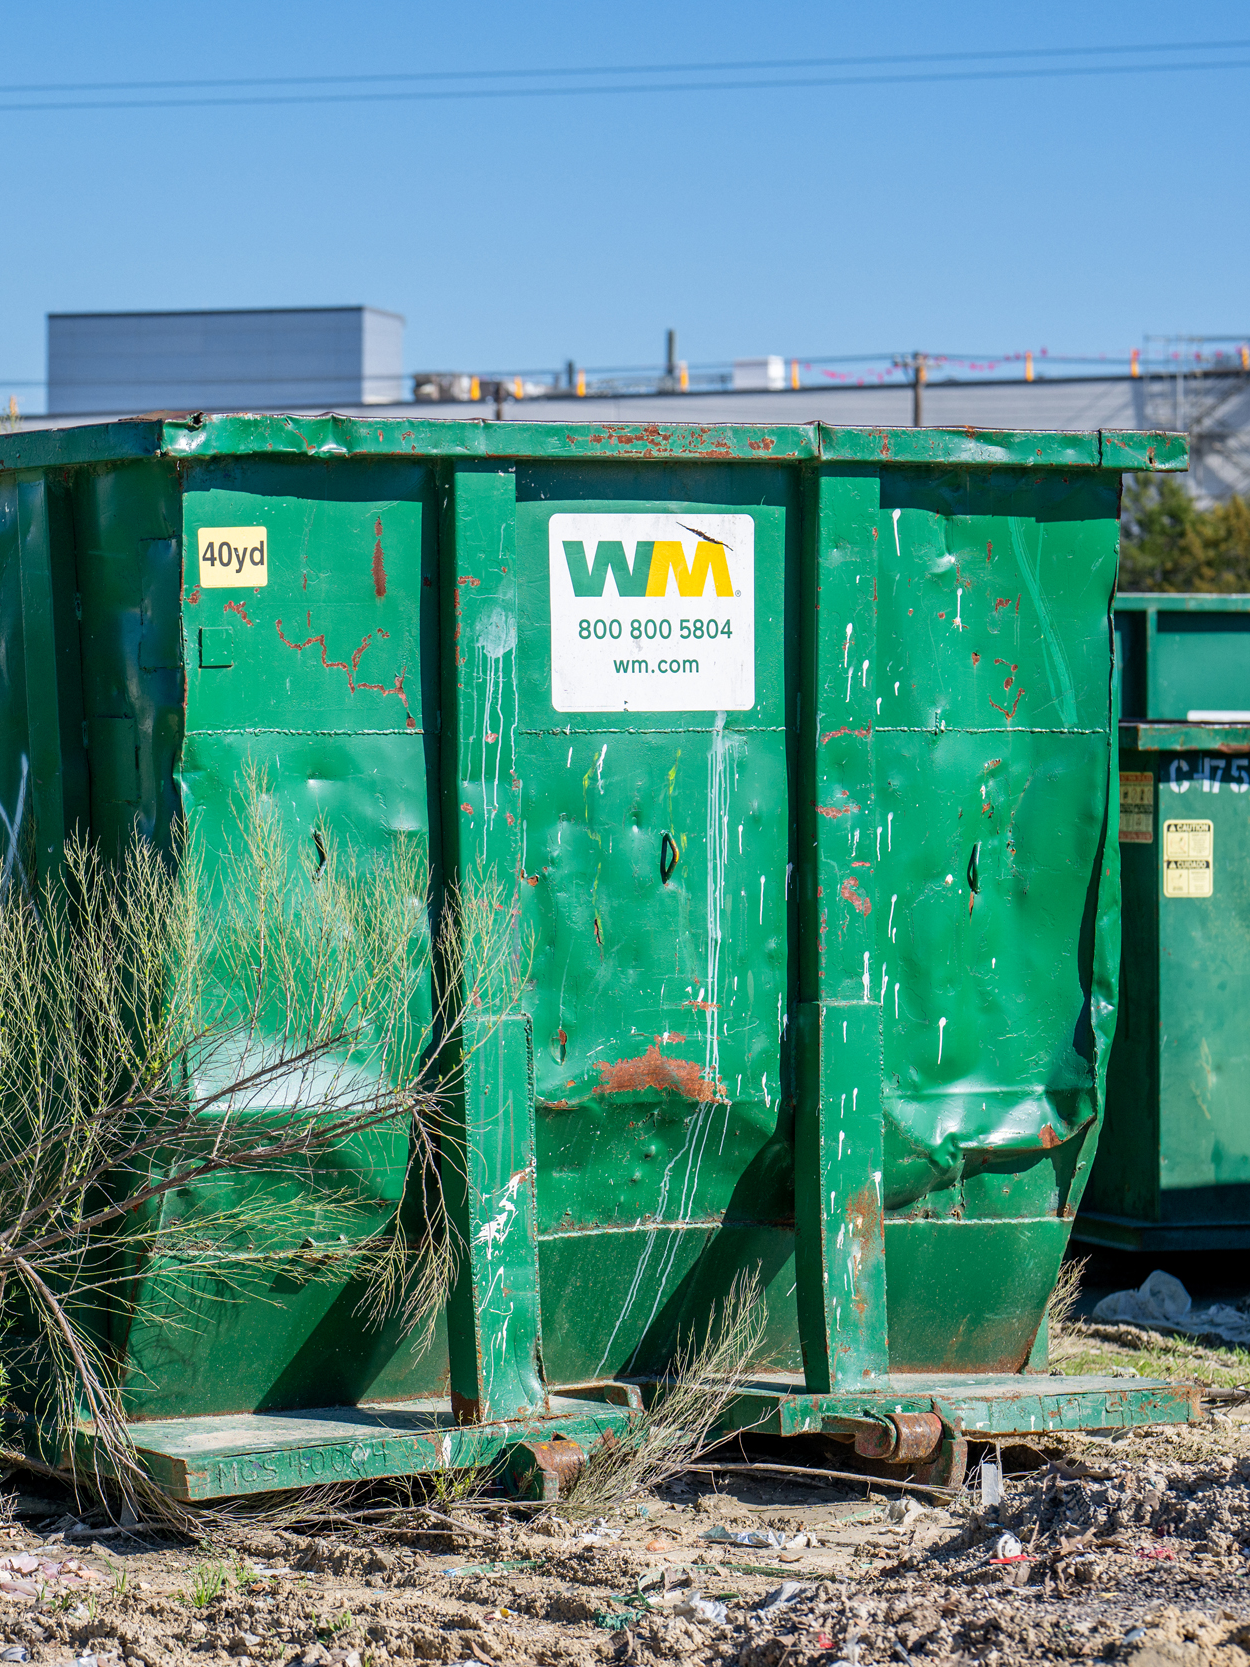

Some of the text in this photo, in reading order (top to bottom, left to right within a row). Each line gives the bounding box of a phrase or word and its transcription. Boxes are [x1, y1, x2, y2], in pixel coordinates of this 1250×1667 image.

[202, 540, 265, 574] 40yd
[562, 541, 734, 597] WM
[578, 619, 733, 639] 800 800 5804
[613, 659, 700, 673] wm.com
[1177, 824, 1209, 832] CAUTION
